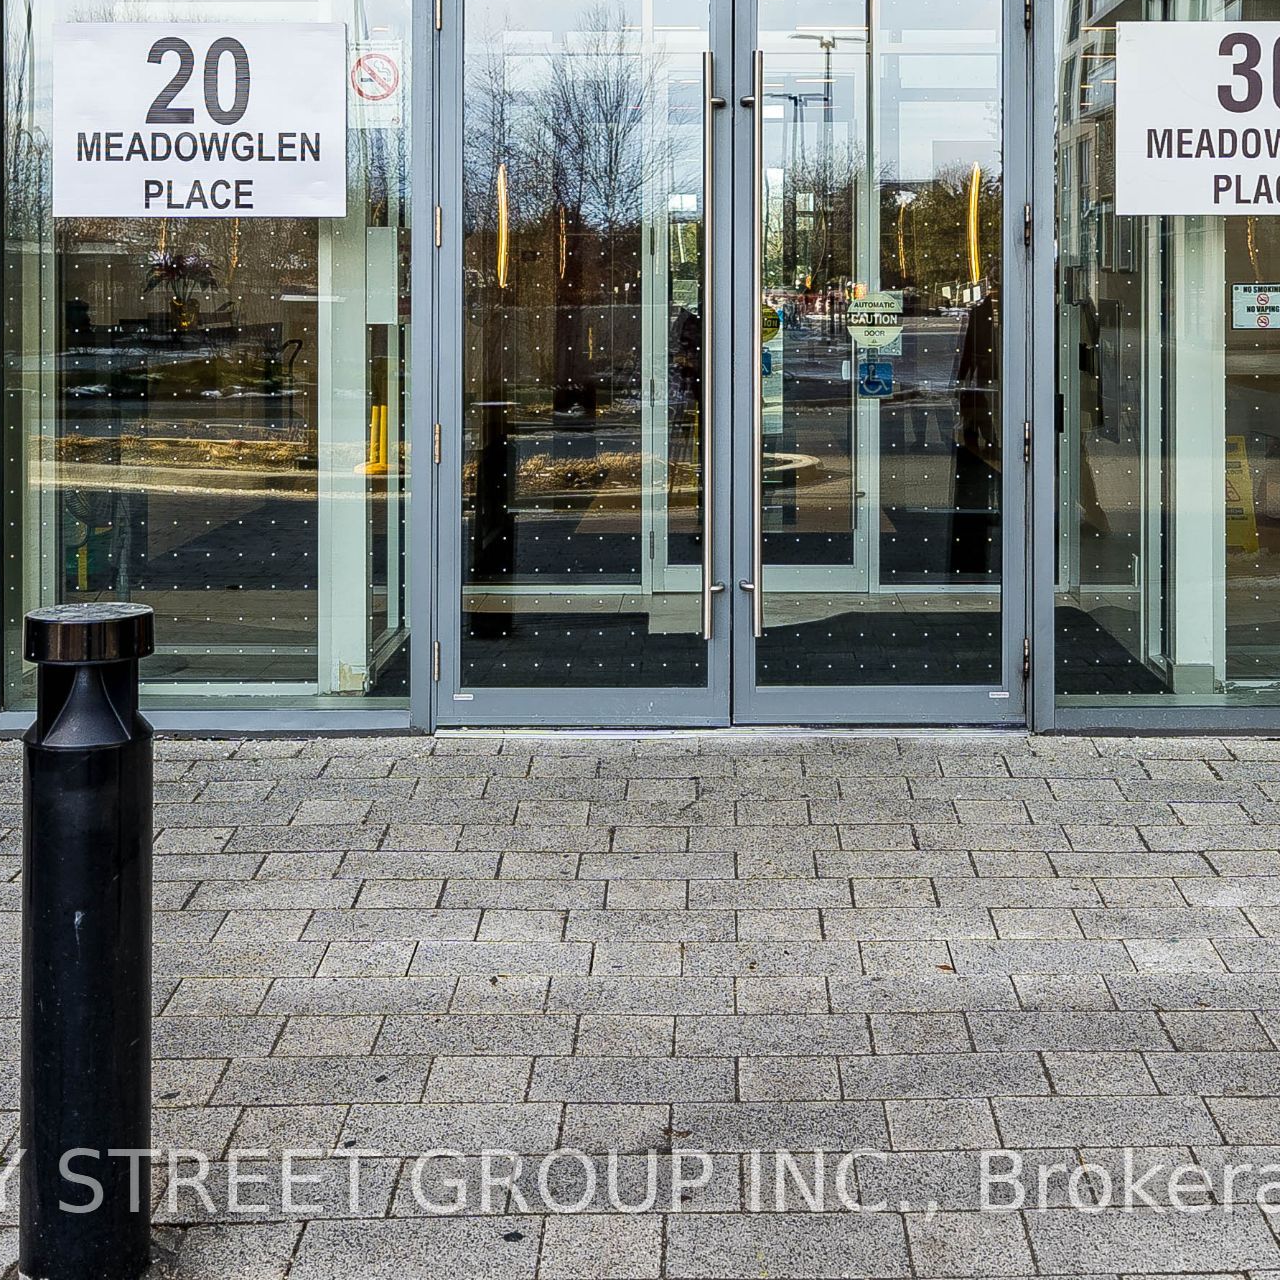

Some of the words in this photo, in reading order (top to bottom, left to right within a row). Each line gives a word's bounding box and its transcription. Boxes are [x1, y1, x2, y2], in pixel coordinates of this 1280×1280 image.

[145, 36, 251, 126] 20
[76, 131, 321, 162] MEADOWGLEN
[144, 179, 254, 210] PLACE
[851, 314, 898, 324] CAUTION
